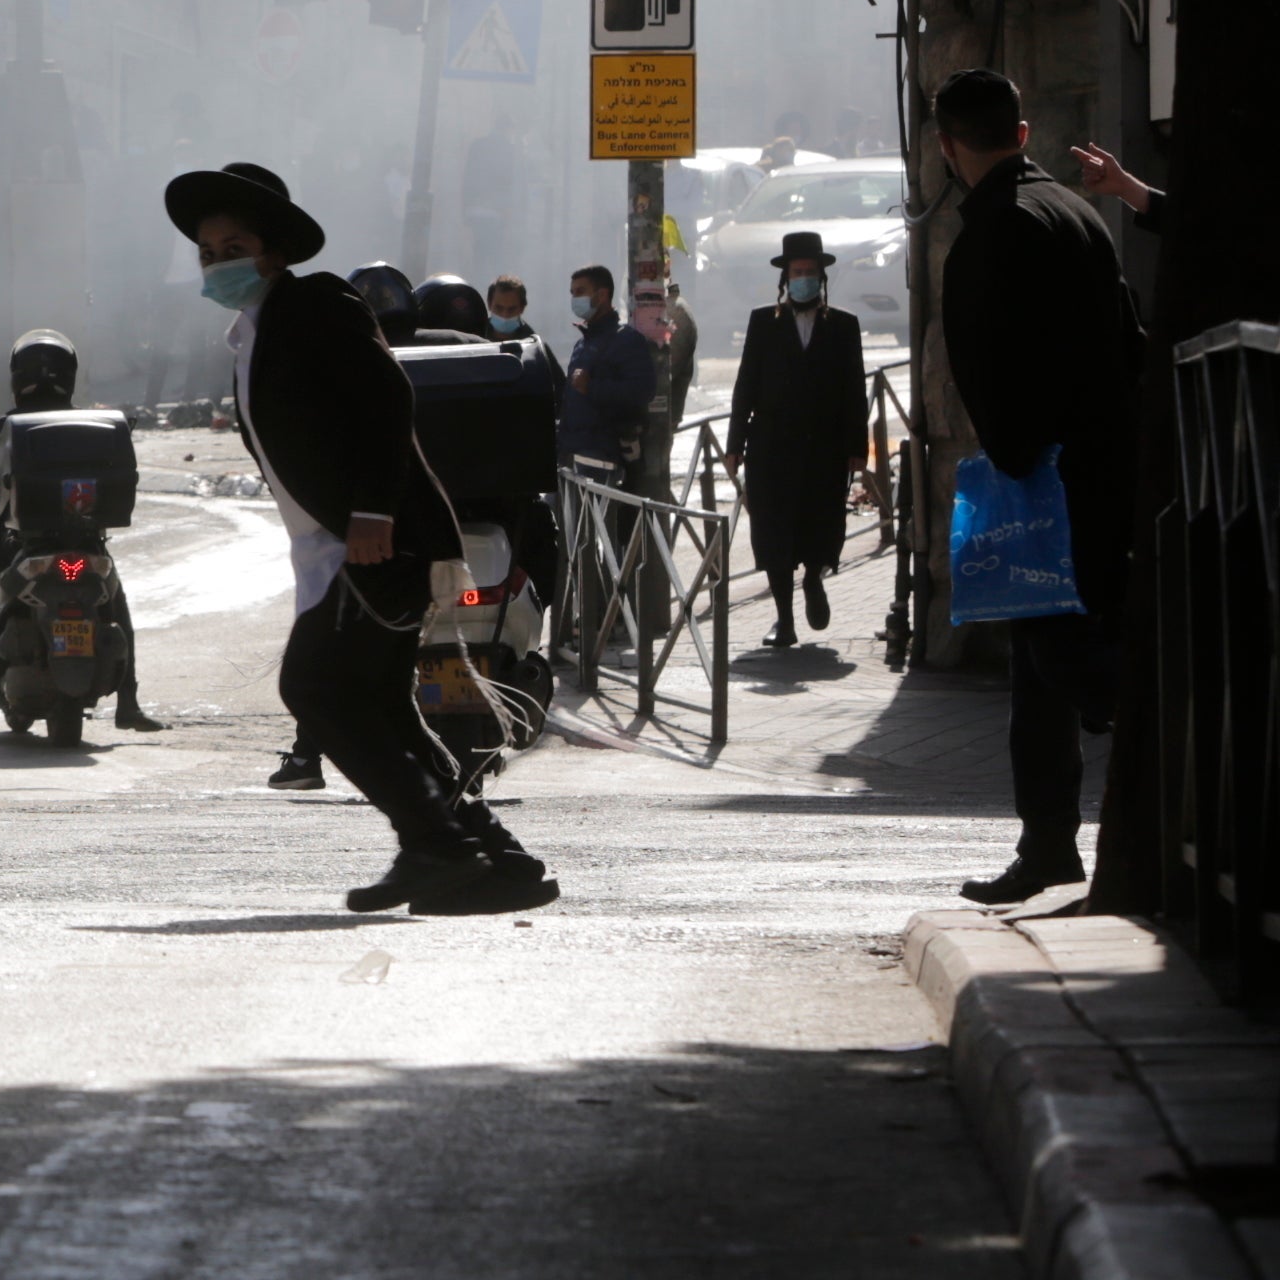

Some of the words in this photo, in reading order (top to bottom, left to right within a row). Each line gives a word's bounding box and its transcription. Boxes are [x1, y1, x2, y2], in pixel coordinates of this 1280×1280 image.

[628, 61, 656, 73] נת"צ
[603, 76, 641, 88] מצלמה
[644, 78, 687, 88] באכיפת
[597, 130, 618, 140] Bus
[621, 130, 647, 140] Lane
[648, 130, 690, 140] Camera
[610, 142, 677, 152] Enforcement
[1008, 564, 1060, 586] הלפרין
